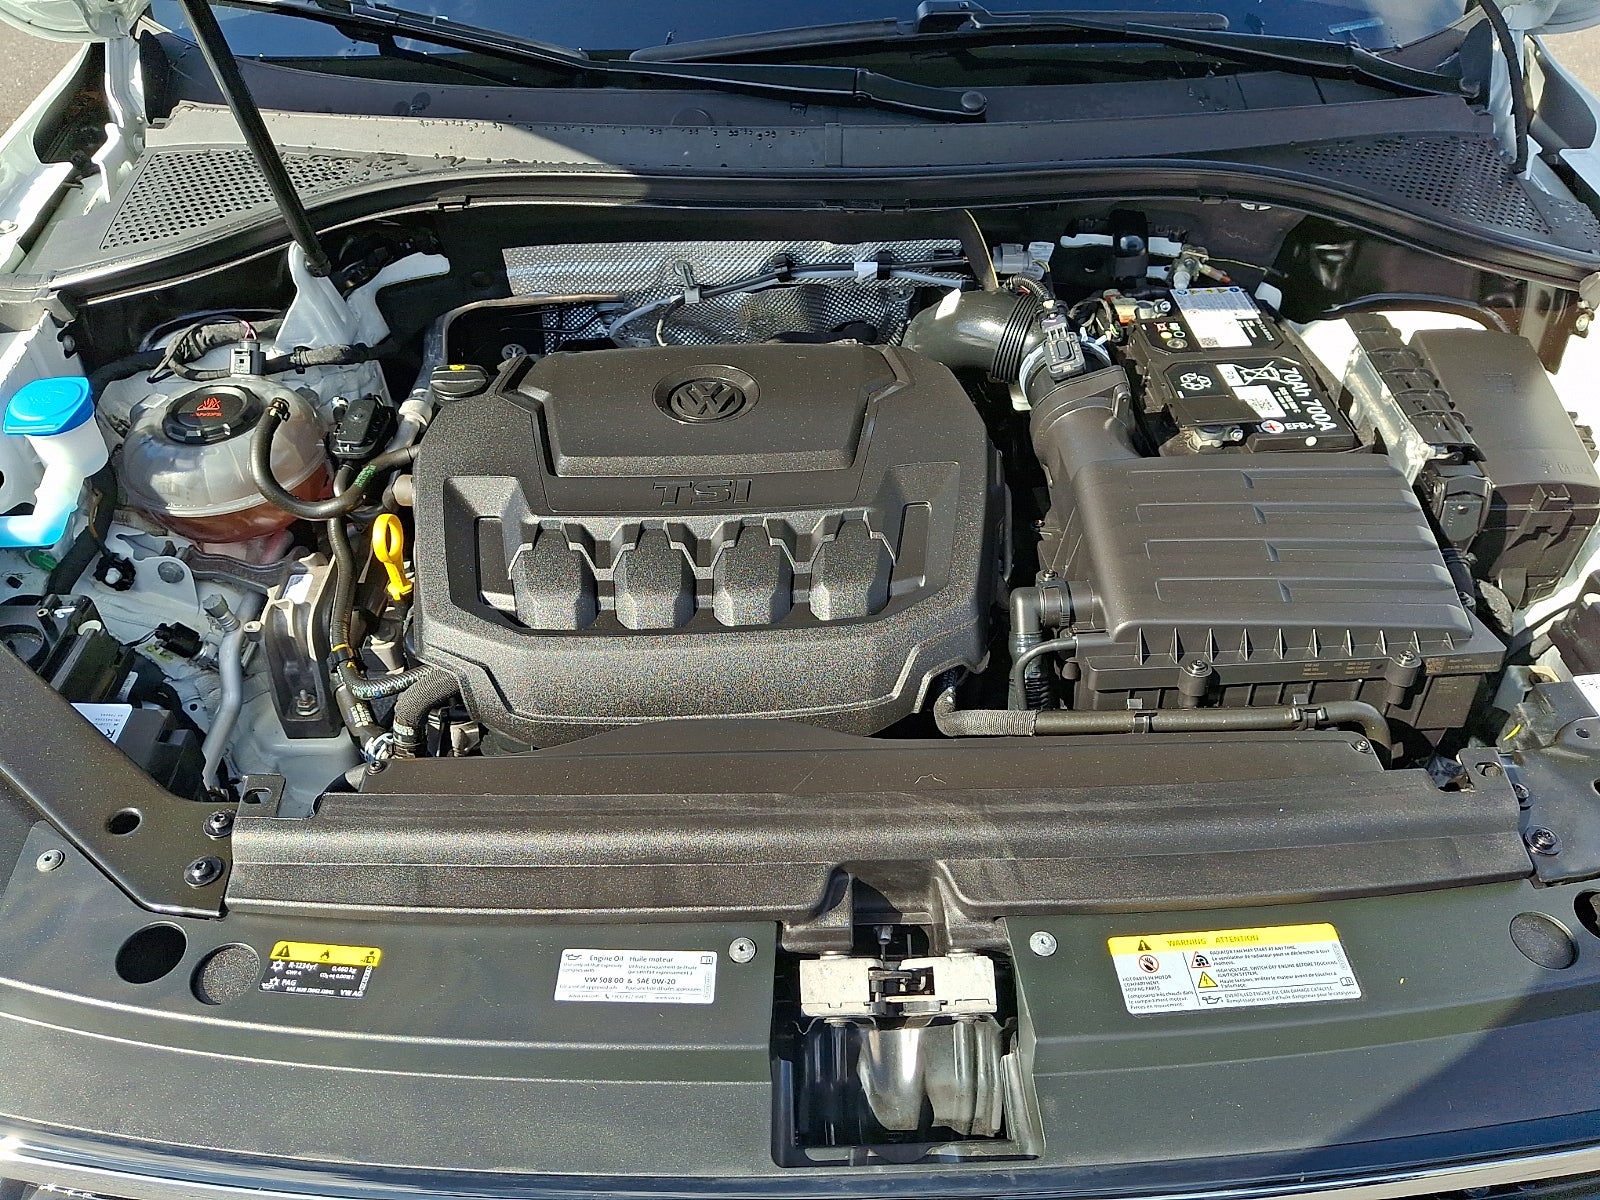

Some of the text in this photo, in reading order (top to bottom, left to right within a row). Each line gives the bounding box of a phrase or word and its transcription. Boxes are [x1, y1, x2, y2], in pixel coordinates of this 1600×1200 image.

[1279, 367, 1312, 396] 70Ah
[1302, 398, 1338, 432] 700A
[1284, 422, 1316, 430] EFB+
[653, 478, 752, 505] TSI
[1167, 935, 1259, 946] WARNING ATTENTION
[590, 955, 612, 963] Engine
[288, 962, 319, 972] R-1234yf
